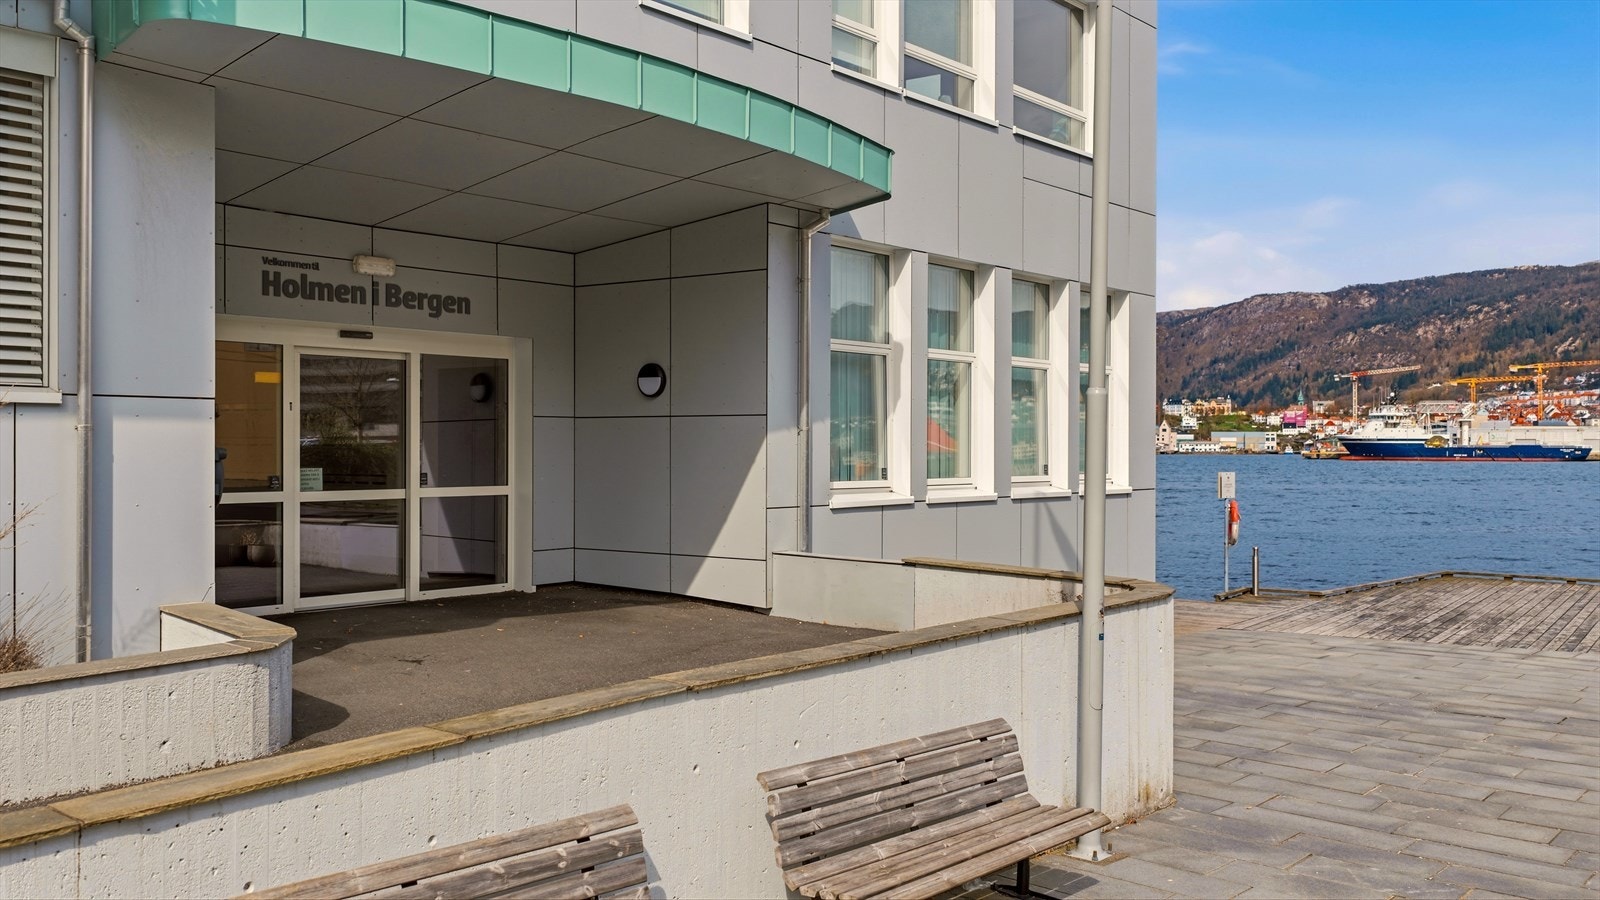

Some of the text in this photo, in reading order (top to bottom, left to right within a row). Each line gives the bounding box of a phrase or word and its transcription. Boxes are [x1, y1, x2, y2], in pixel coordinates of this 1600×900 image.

[261, 256, 320, 271] Velkommen til
[261, 270, 471, 319] Holmen i Bergen
